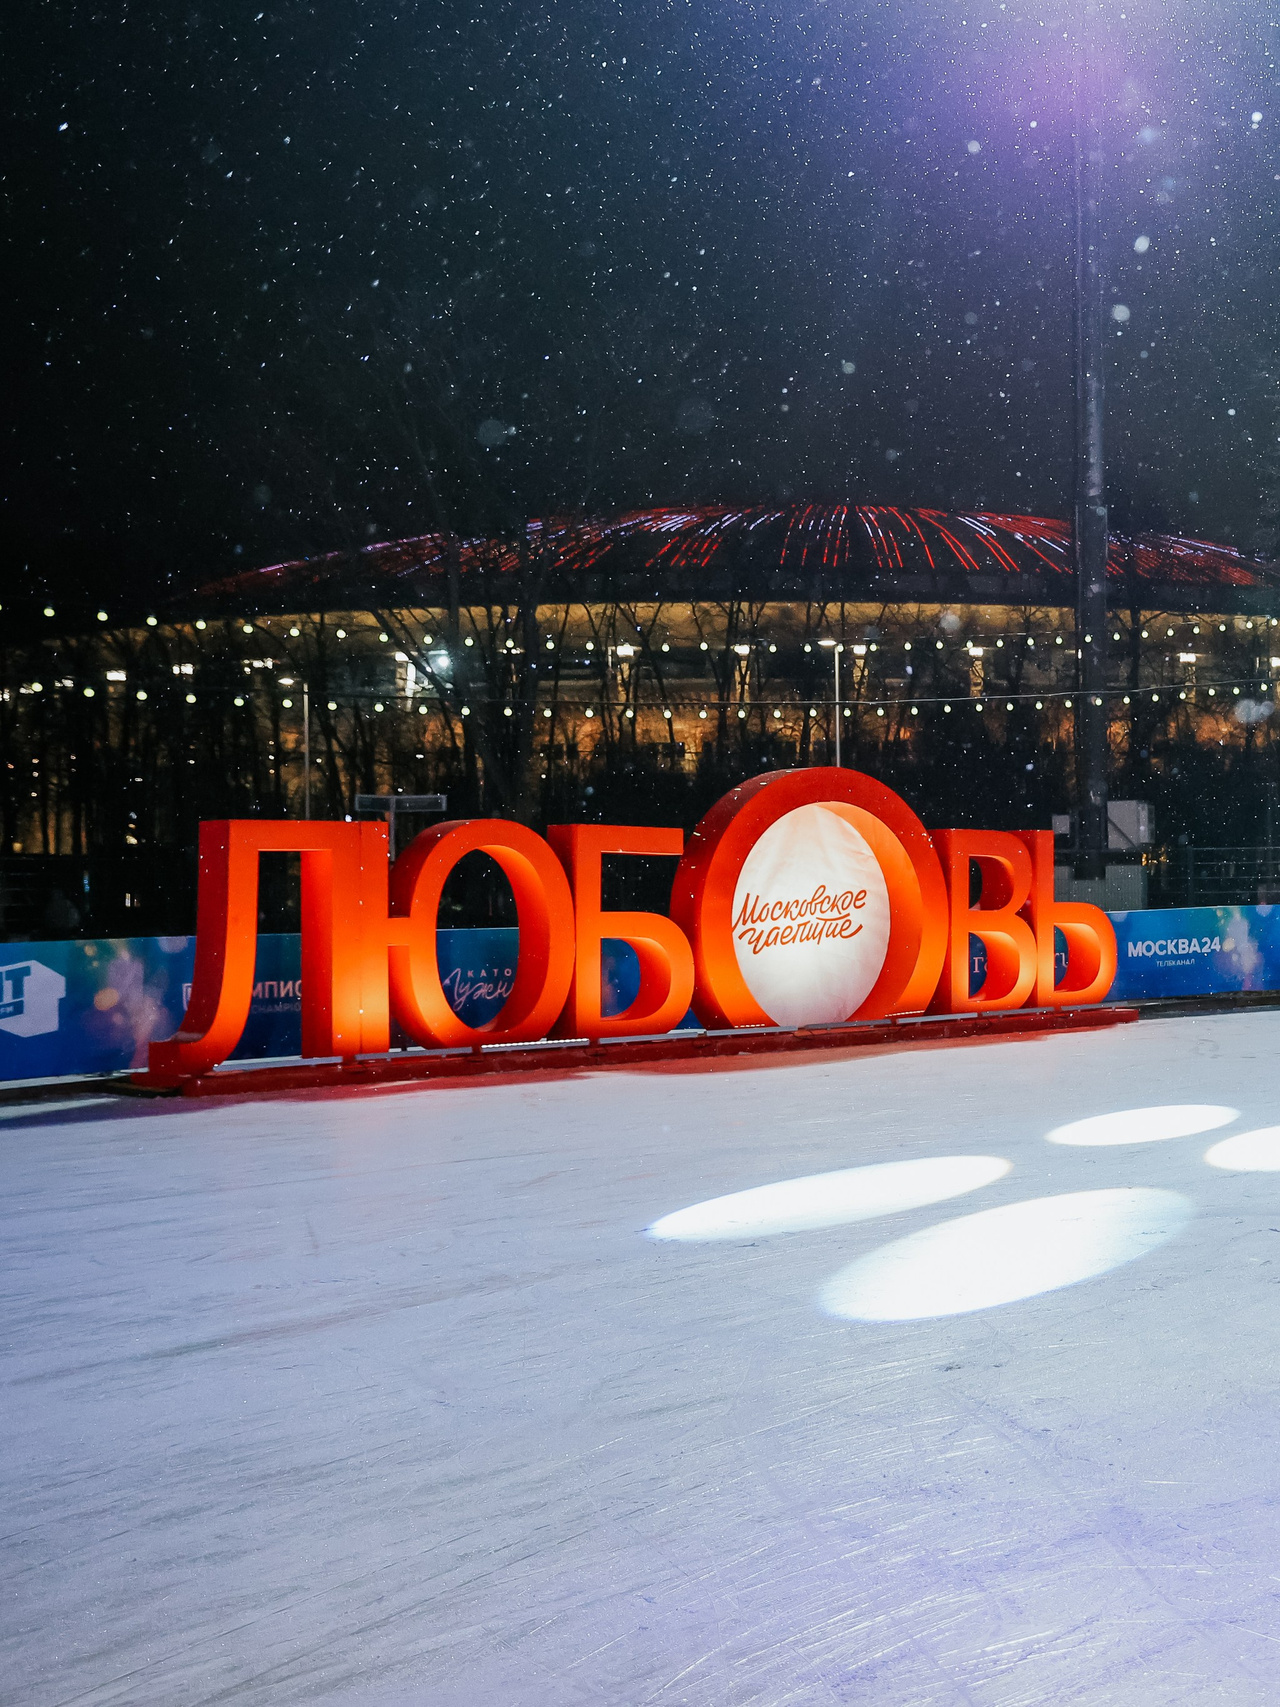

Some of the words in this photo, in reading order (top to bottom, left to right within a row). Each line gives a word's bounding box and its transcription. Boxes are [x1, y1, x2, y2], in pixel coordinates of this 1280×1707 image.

[149, 768, 1118, 1078] ЛЮБОВЬ
[732, 884, 868, 932] Московское
[738, 913, 864, 955] чаепитие
[467, 968, 512, 978] КАТО
[1156, 958, 1195, 968] ТЕЛЕКАНАЛ
